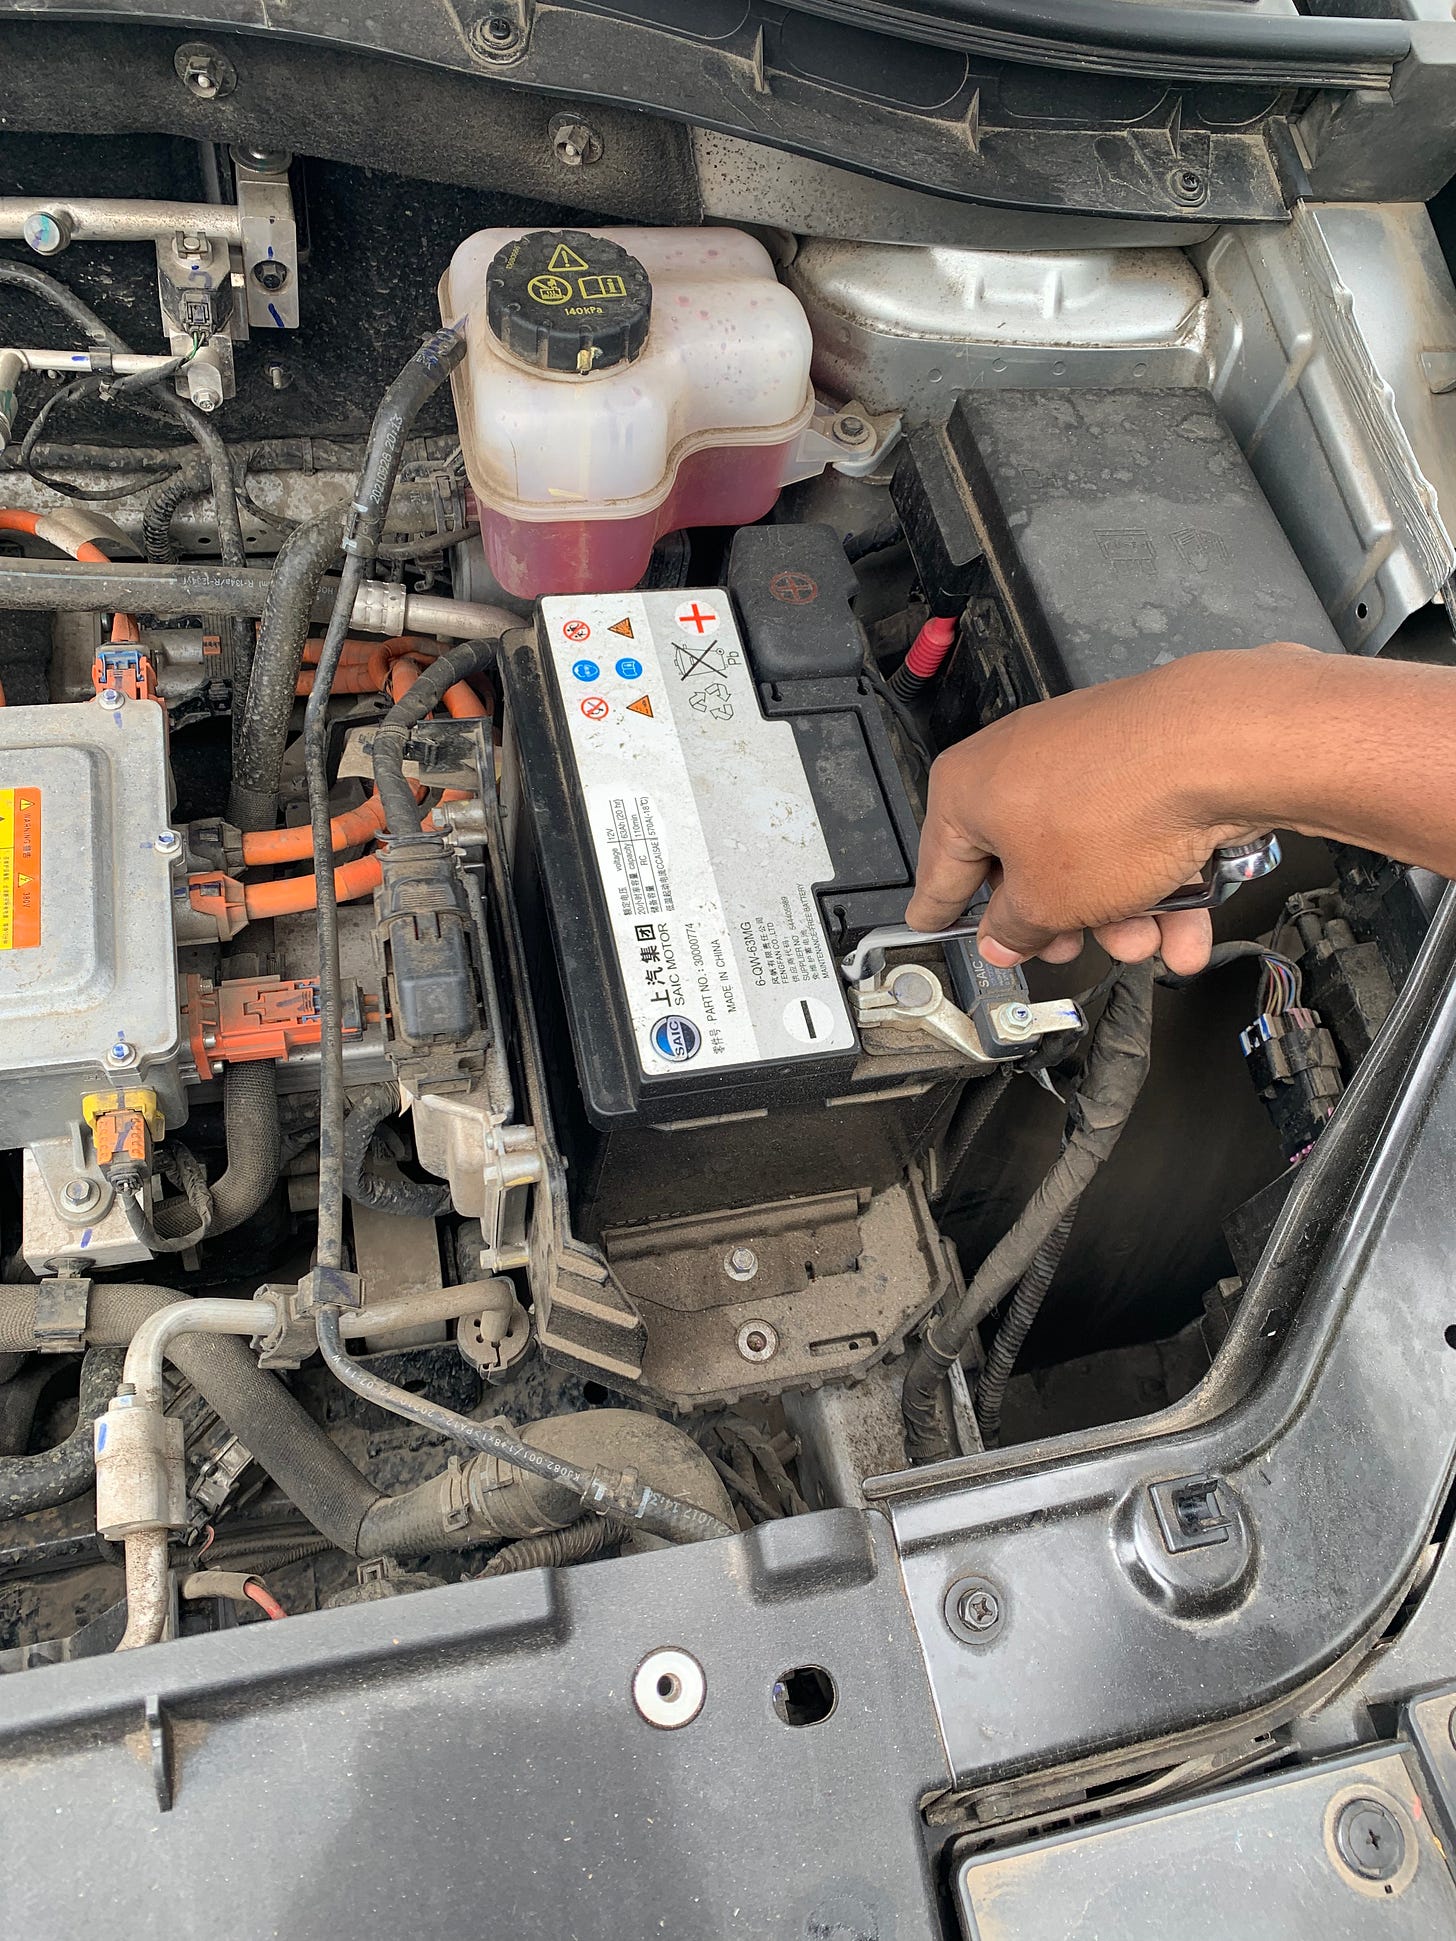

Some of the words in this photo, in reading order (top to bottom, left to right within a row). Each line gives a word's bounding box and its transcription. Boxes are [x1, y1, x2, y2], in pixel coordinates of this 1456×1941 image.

[726, 651, 742, 666] Pb
[606, 828, 615, 840] 12V
[618, 822, 628, 839] 63Ah
[631, 814, 641, 837] 110min
[612, 848, 622, 872] voltage
[624, 843, 636, 870] capacity
[639, 855, 648, 866] RC
[797, 883, 811, 912] BATTERY
[657, 922, 677, 970] MOTOR
[711, 939, 726, 968] CHINA
[740, 921, 766, 987] 6-QW-63MG
[635, 924, 671, 1007] 上汽集团
[719, 971, 728, 981] IN
[774, 950, 789, 984] FENGFAN
[794, 948, 810, 981] SUPPLIER
[972, 960, 989, 988] SAIC
[669, 973, 685, 1006] SAIC
[721, 985, 737, 1013] MADE
[702, 995, 717, 1022] PART
[670, 1021, 685, 1056] SAIC
